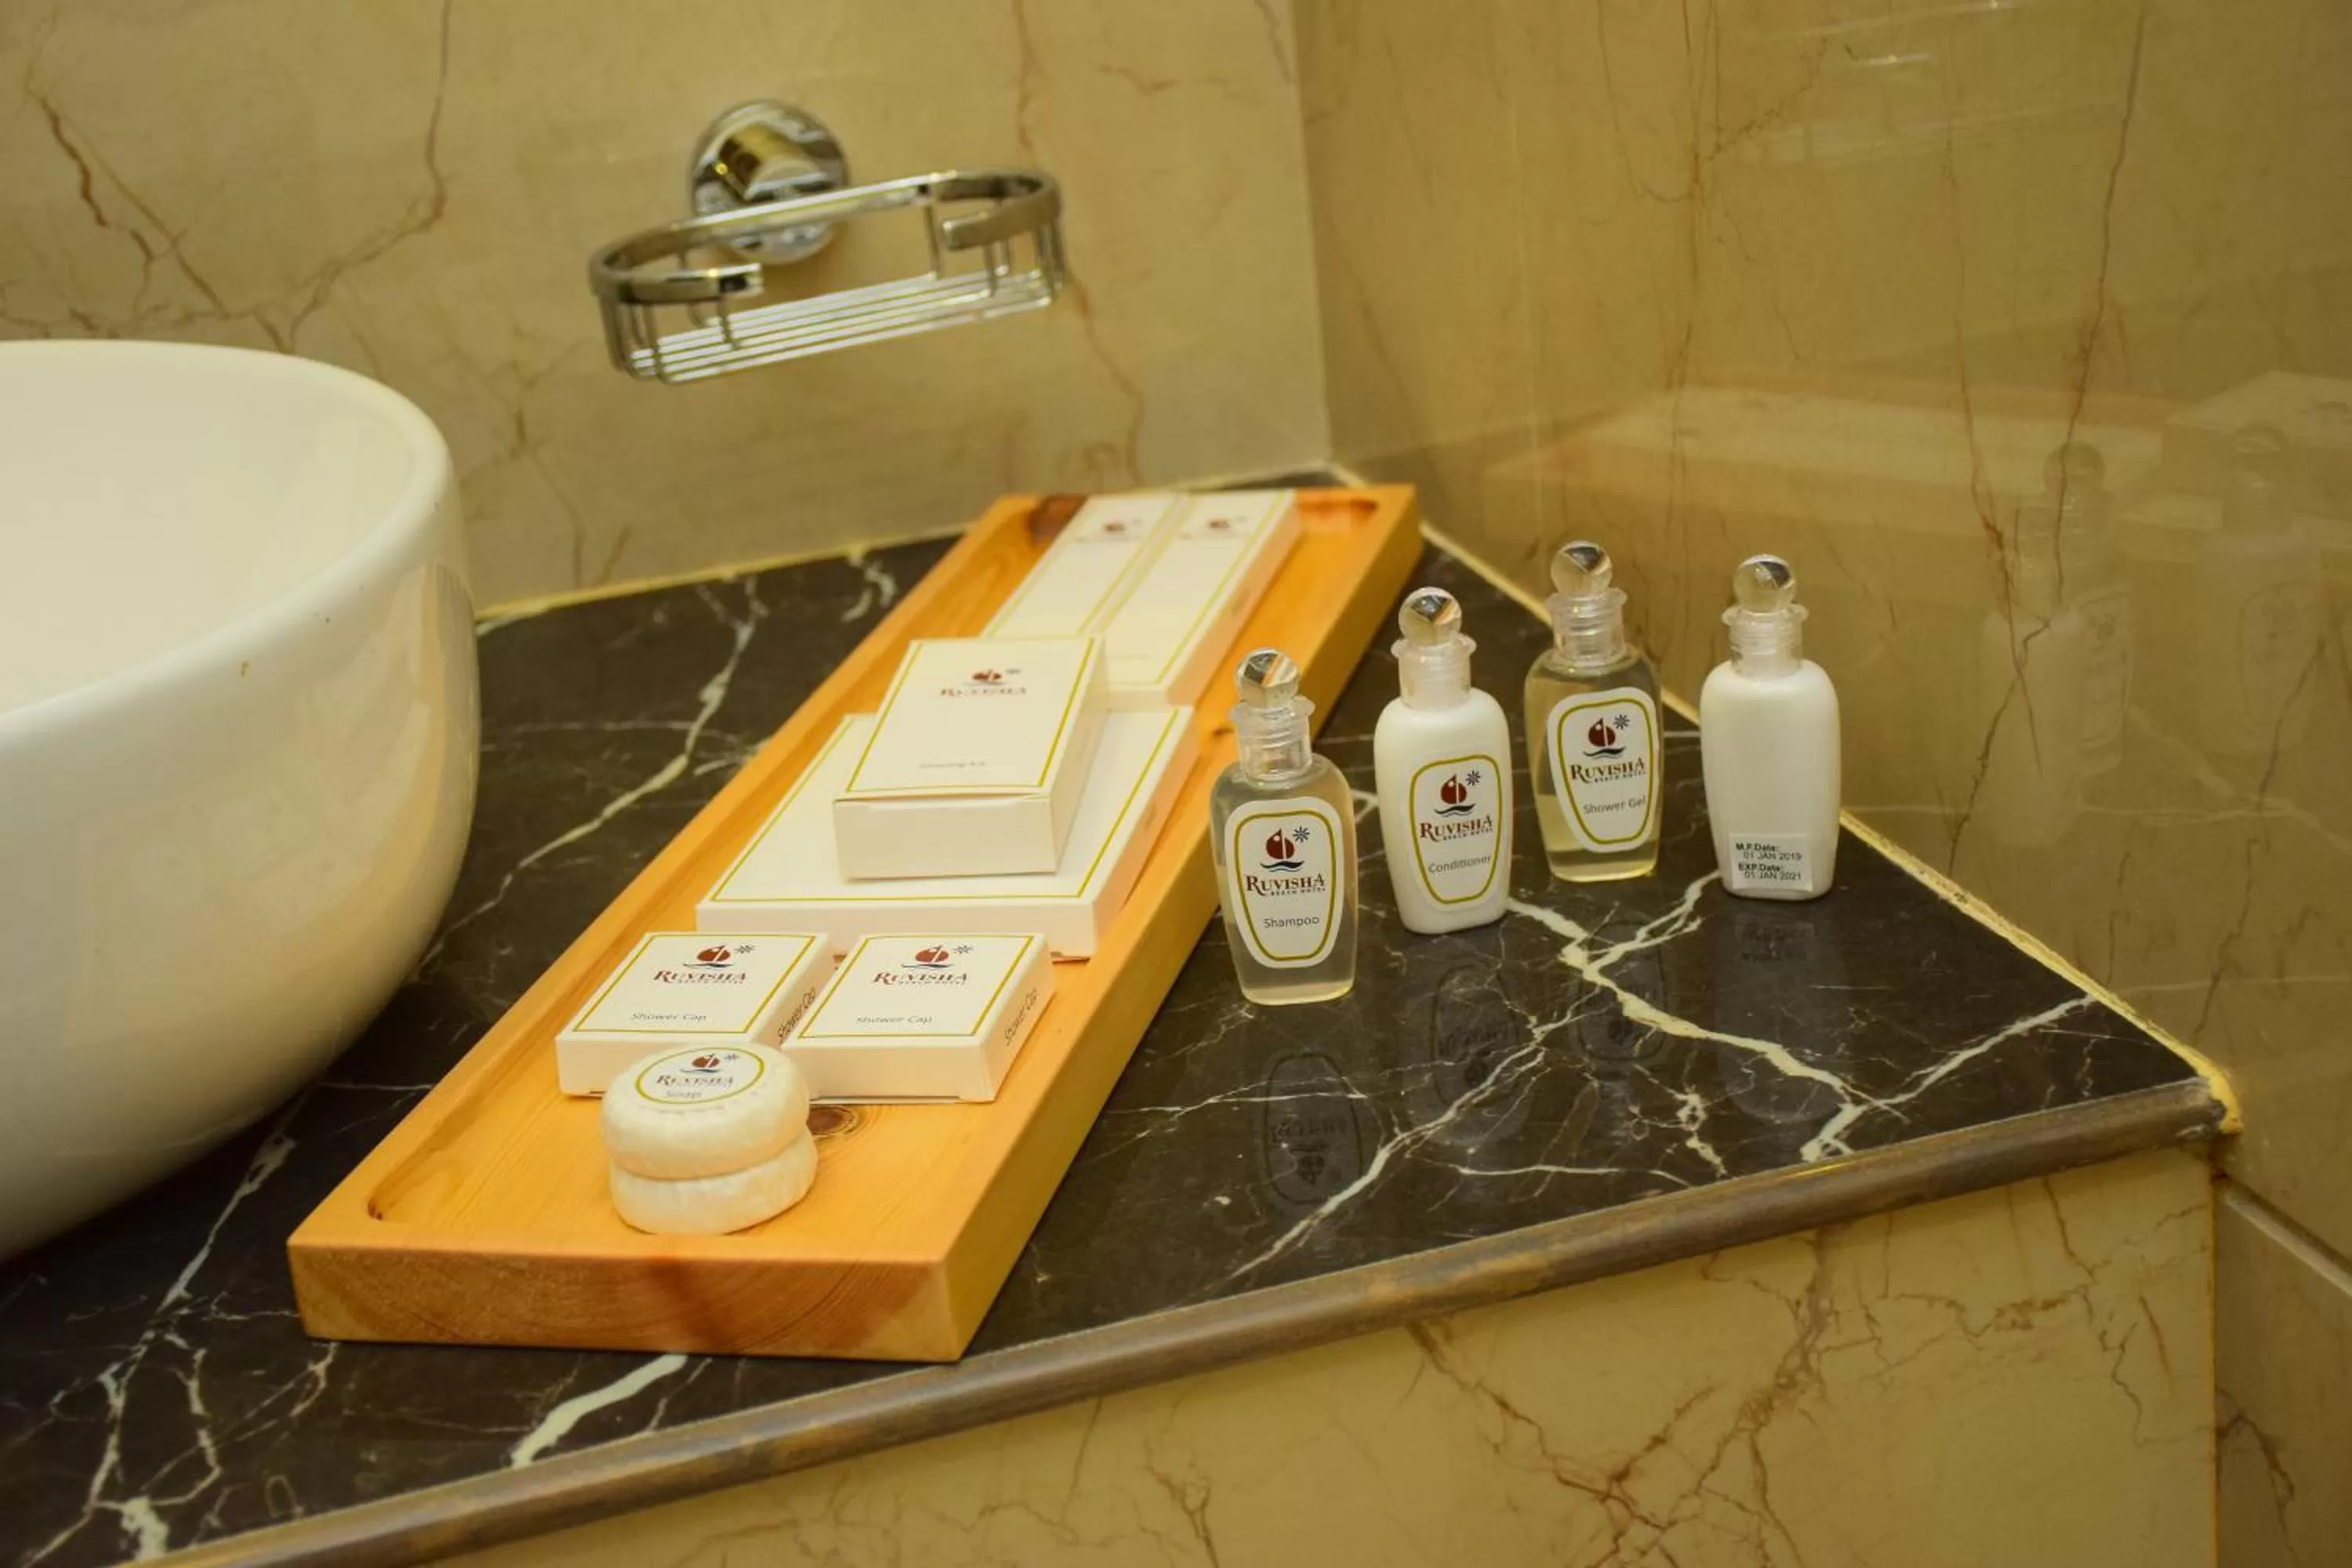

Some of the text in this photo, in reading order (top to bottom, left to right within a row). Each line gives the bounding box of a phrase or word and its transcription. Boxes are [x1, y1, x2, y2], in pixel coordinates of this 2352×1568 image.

[1570, 757, 1645, 783] RUVISHA
[1582, 794, 1646, 814] Shower Gel
[1420, 815, 1493, 843] RUVISHA
[1428, 855, 1491, 873] Conditioner
[1245, 873, 1325, 896] RUVISHA
[1263, 916, 1319, 928] Shampoo
[653, 971, 746, 983] RUVISHA
